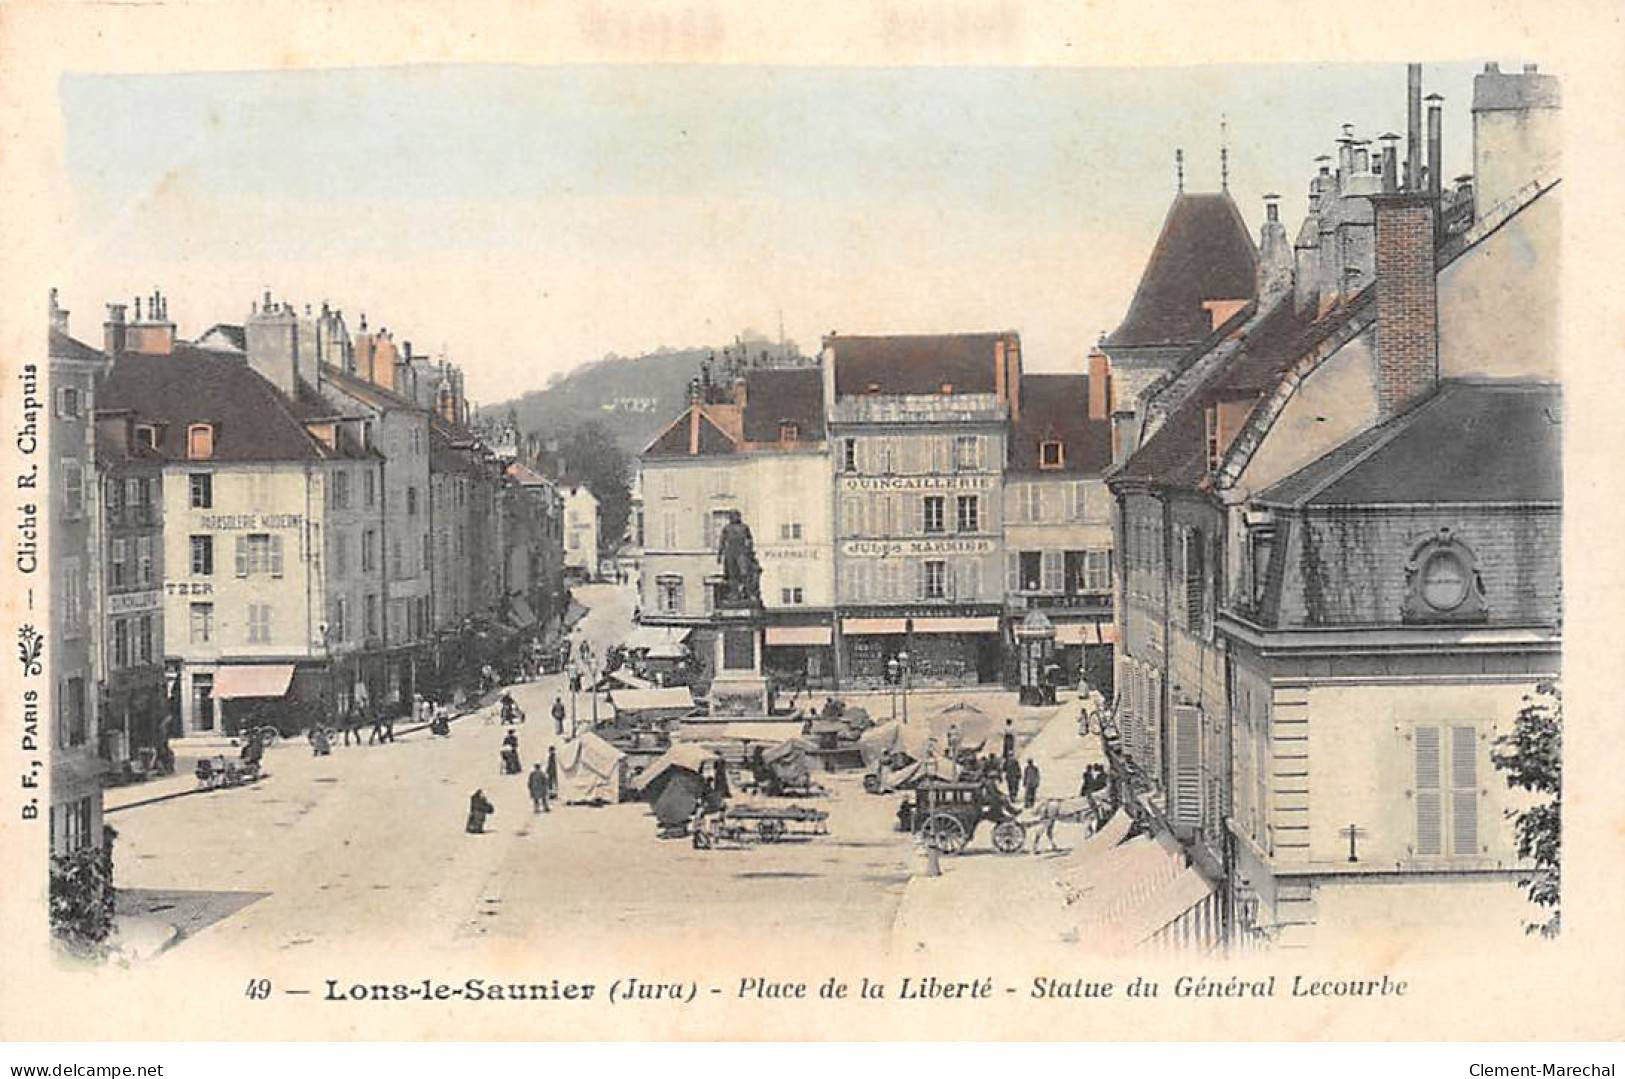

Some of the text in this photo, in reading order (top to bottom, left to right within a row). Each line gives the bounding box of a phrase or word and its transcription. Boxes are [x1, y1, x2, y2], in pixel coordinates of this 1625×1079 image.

[17, 364, 44, 574] Cliché R. Chapuis
[847, 540, 903, 553] JULES
[21, 690, 38, 751] PARIS
[245, 975, 1408, 1003] 49 Lons-le-Saunier (Jura) Place de la Liberté Statue du Général Lecourbe
